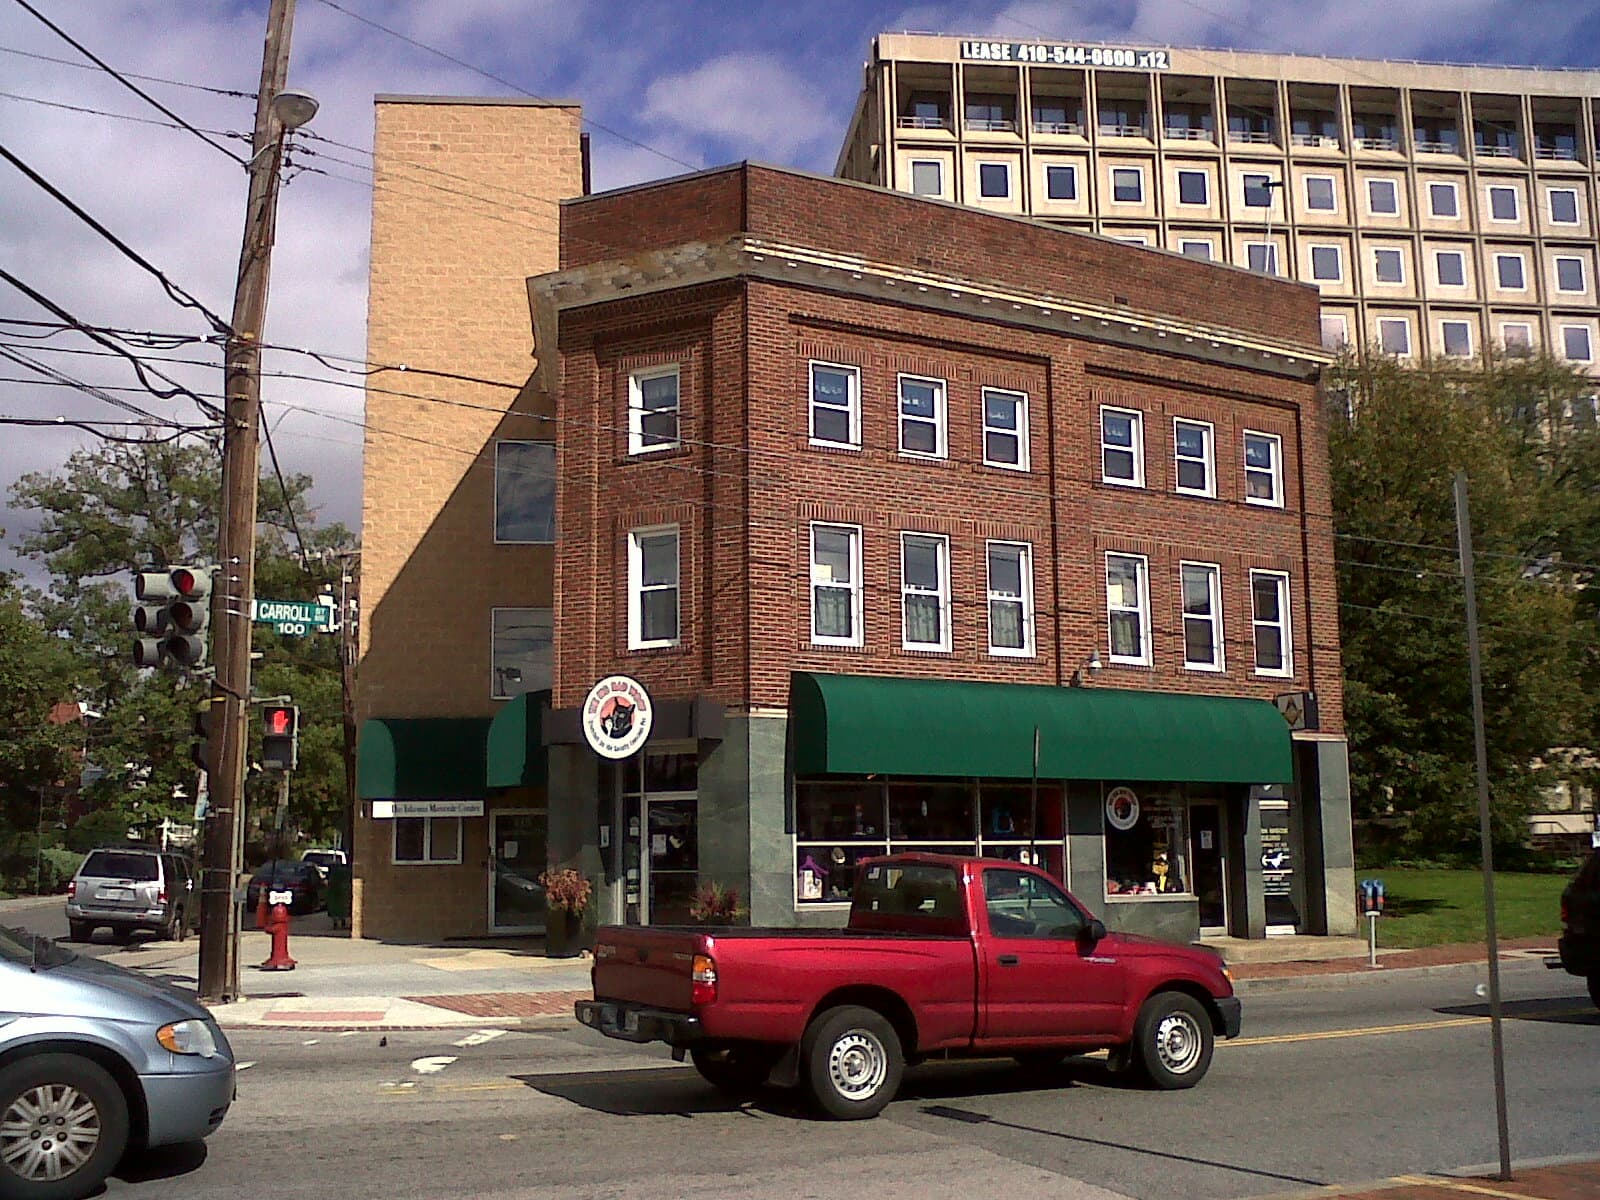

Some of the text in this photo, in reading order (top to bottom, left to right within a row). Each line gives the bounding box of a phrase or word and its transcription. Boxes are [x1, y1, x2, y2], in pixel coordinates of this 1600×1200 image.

[963, 42, 1011, 60] LEASE
[1138, 51, 1168, 69] x12
[260, 603, 312, 622] CARROLL
[277, 622, 306, 635] 100
